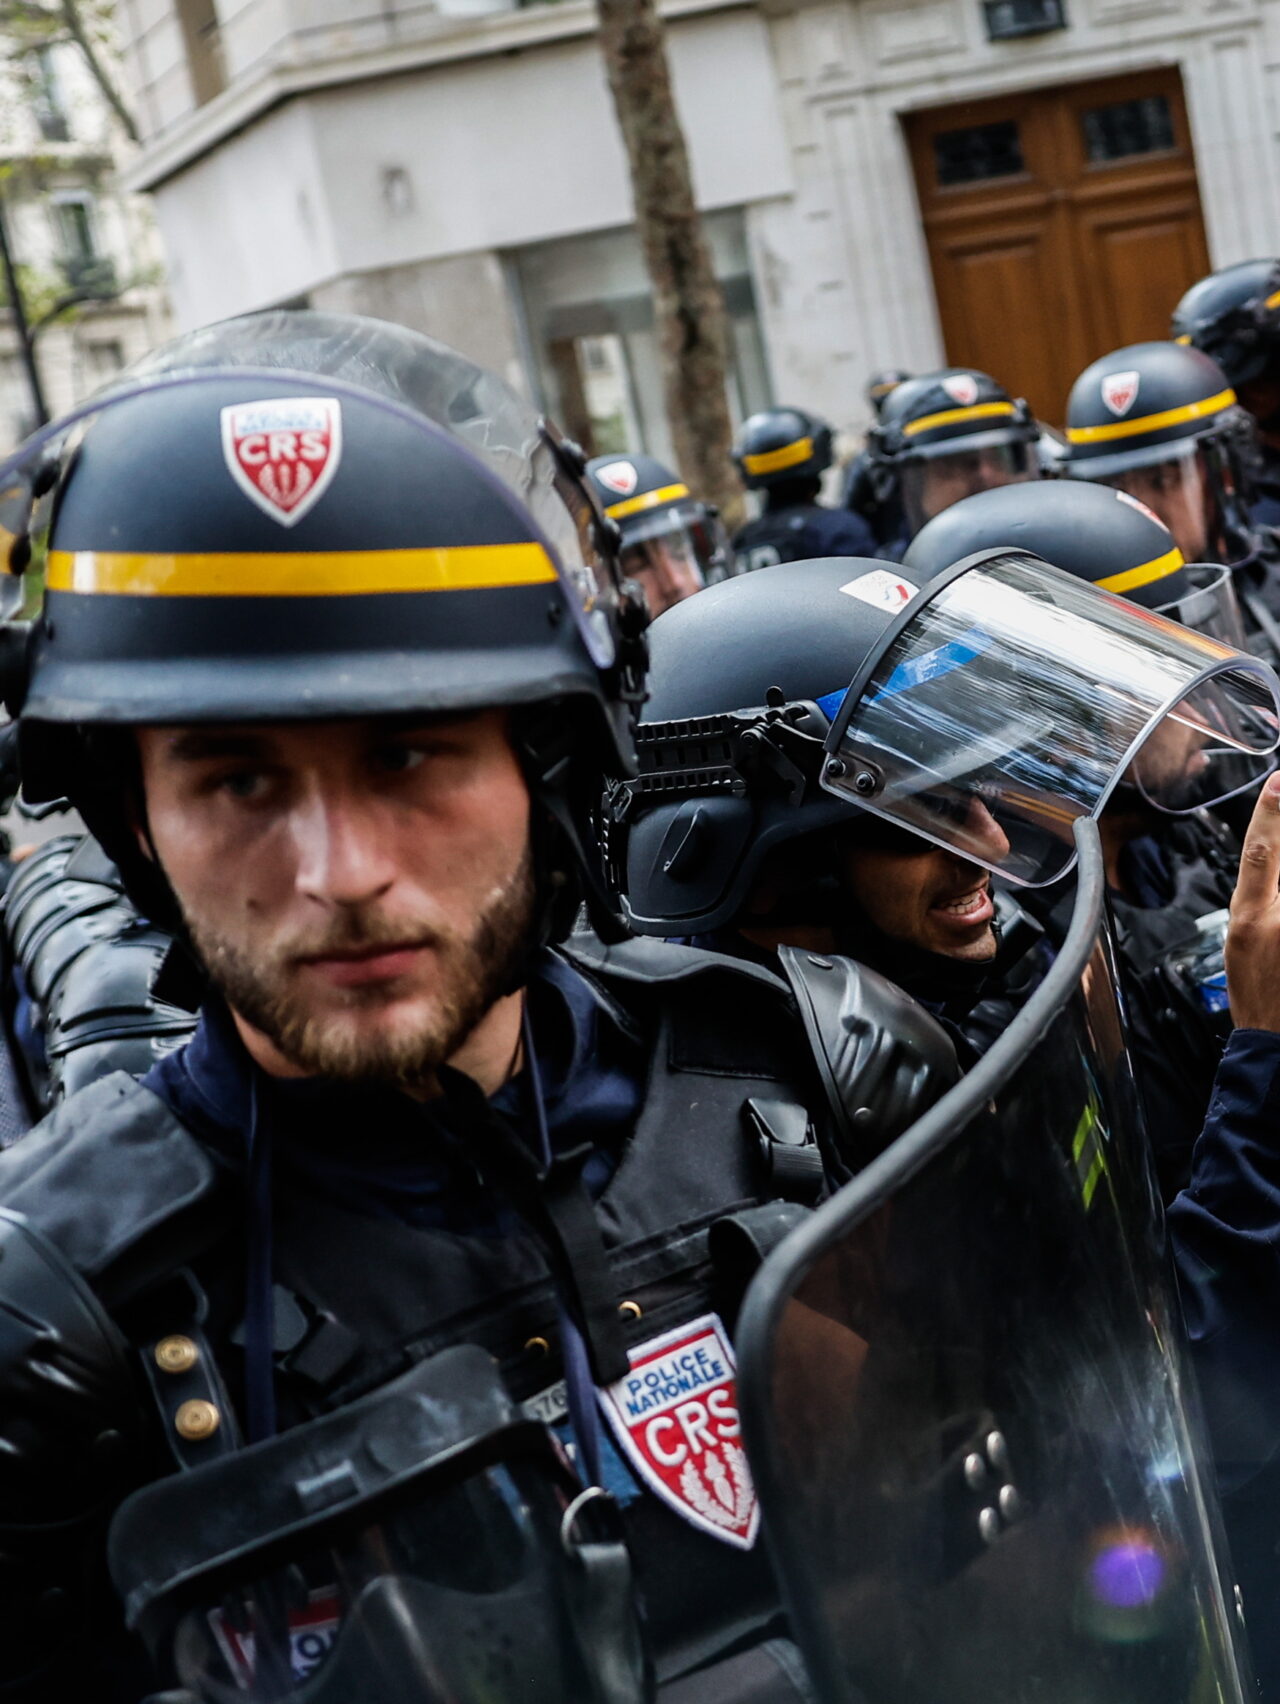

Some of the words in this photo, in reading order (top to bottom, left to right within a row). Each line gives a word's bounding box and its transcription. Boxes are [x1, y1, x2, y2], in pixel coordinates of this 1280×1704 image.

[239, 430, 328, 464] CRS
[626, 1348, 709, 1396] POLICE
[626, 1360, 725, 1416] NATIONALE
[645, 1388, 741, 1467] CRS
